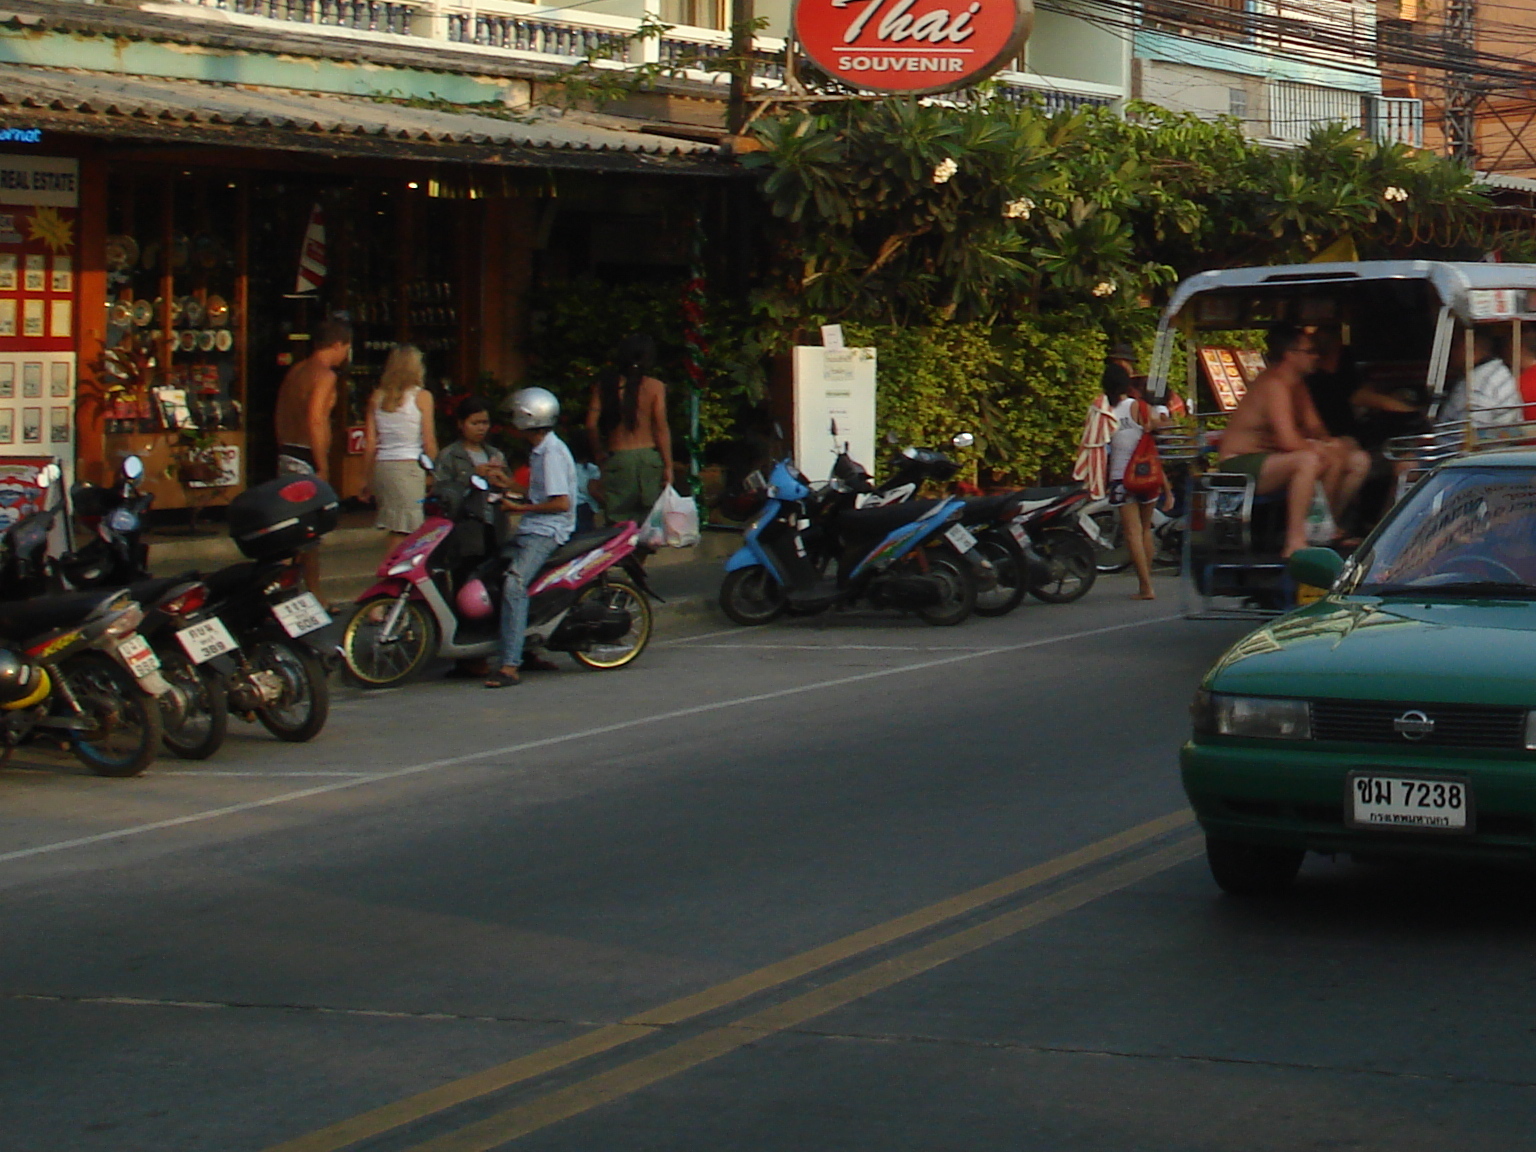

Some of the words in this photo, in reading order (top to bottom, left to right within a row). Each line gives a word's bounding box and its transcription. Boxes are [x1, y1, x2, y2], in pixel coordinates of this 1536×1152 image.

[838, 56, 963, 73] SOUVENIR
[33, 170, 76, 191] ESTATE
[1401, 781, 1462, 809] 7238
